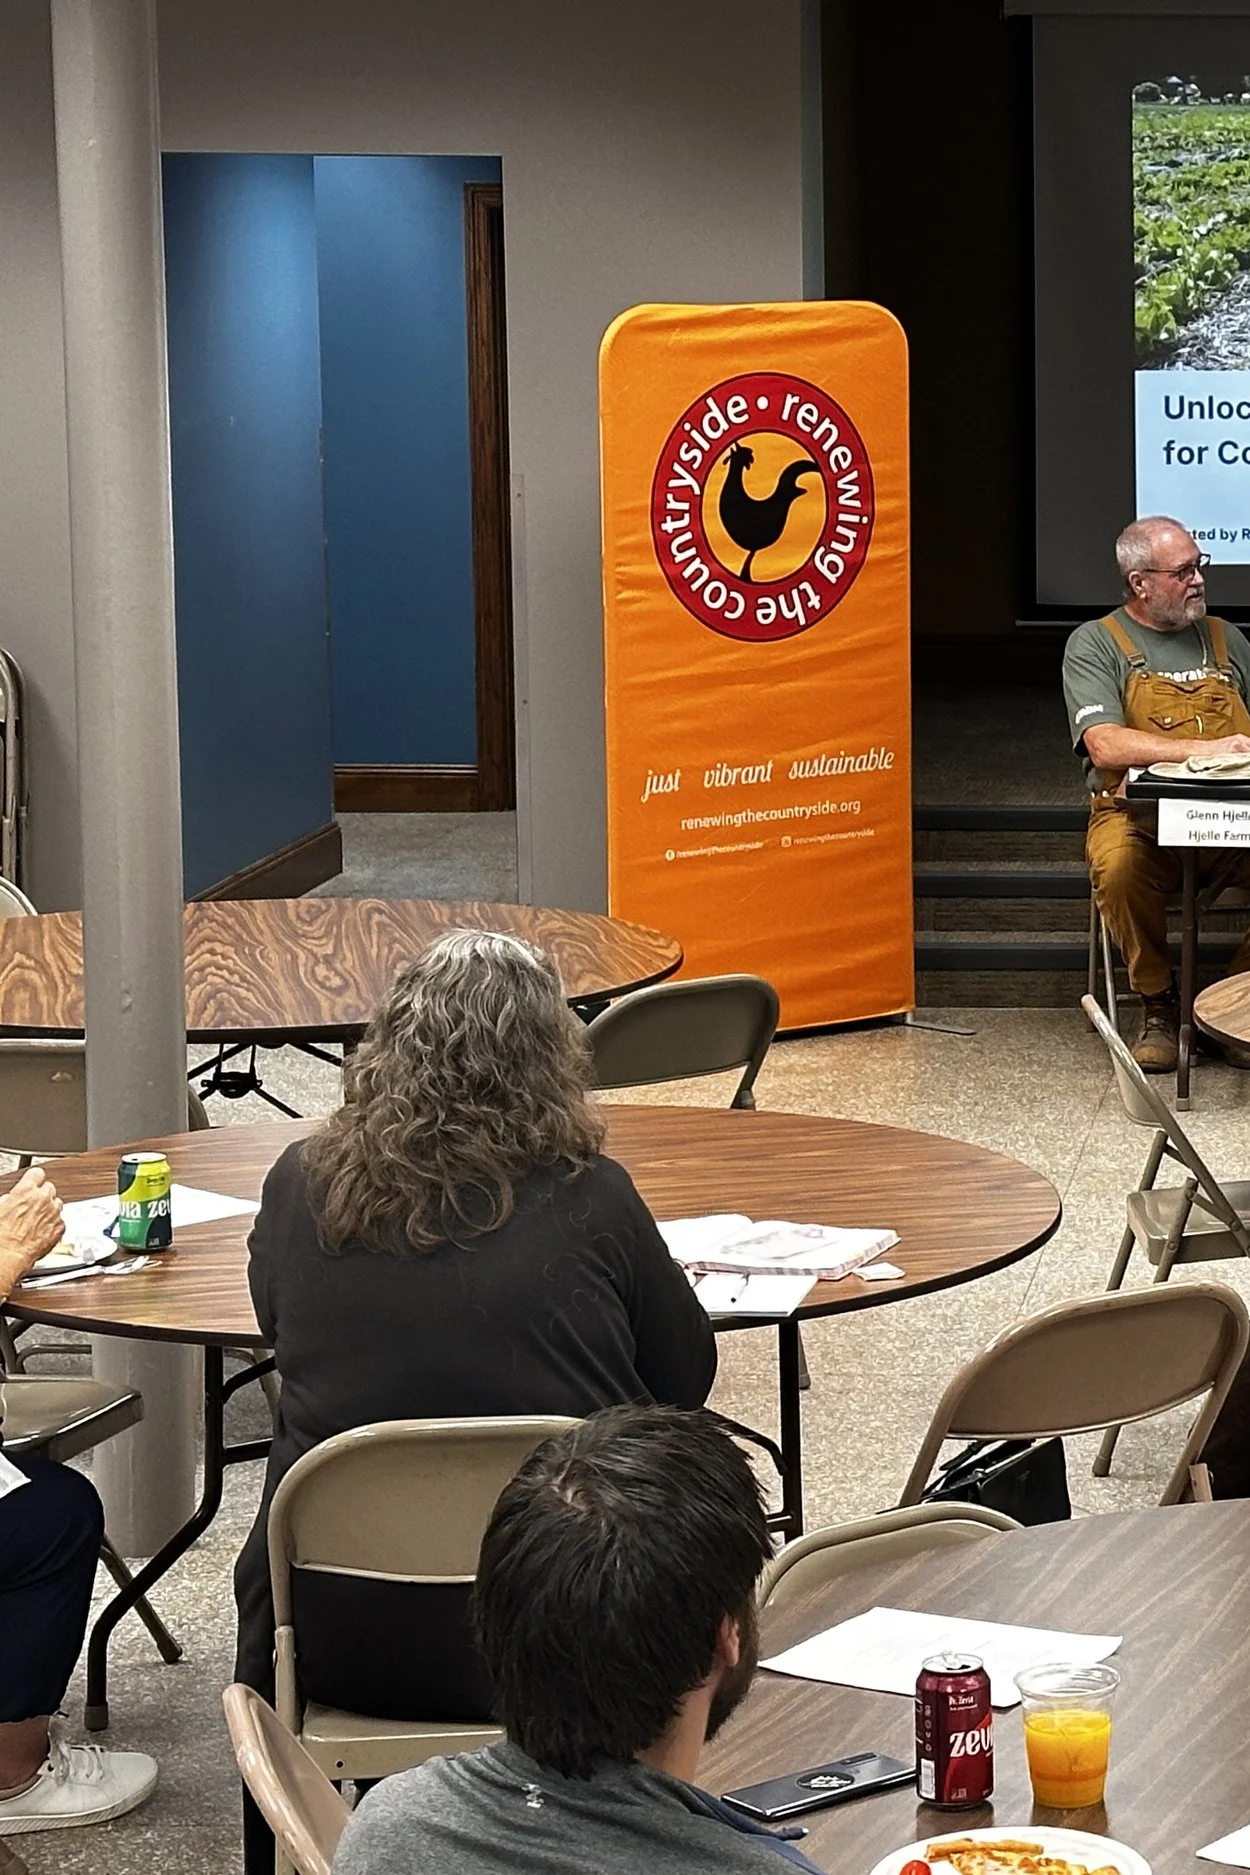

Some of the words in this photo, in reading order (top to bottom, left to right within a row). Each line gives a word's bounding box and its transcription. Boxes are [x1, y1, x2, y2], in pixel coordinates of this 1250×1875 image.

[1163, 440, 1208, 465] for
[781, 393, 869, 585] renewing
[660, 395, 749, 620] countryside
[1220, 528, 1238, 543] by
[755, 581, 821, 626] the
[641, 769, 681, 803] just
[703, 759, 774, 788] vibrant
[788, 747, 895, 781] sustainable
[680, 800, 861, 831] renewingthecountryside.org
[1186, 809, 1219, 820] Glenn
[1189, 830, 1220, 842] Hjelle
